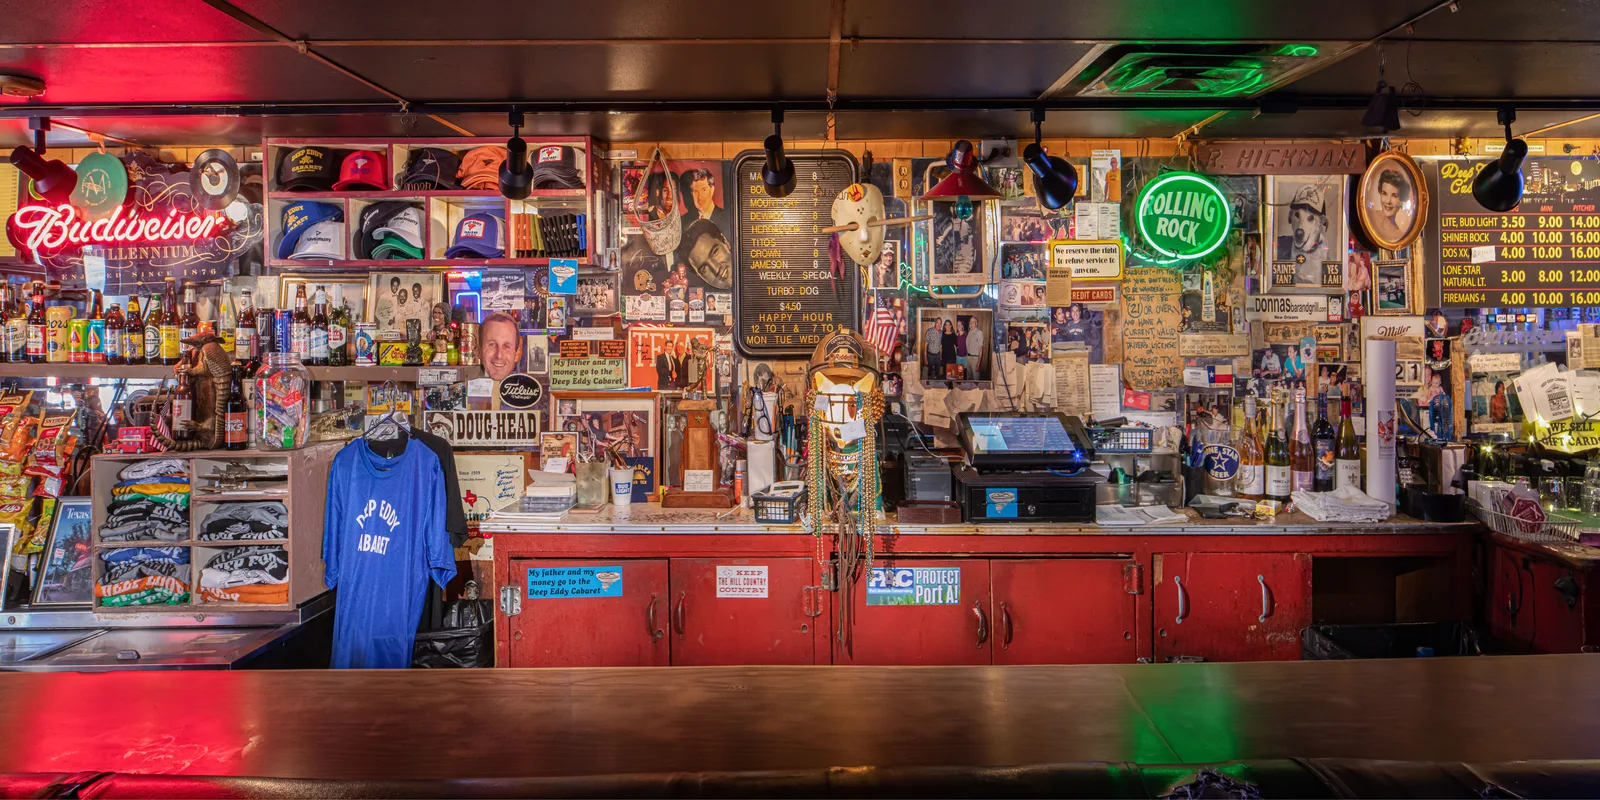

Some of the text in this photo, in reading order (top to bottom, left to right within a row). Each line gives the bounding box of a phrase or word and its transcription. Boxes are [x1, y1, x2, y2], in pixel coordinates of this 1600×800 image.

[1206, 149, 1356, 168] R. HICKMAN
[812, 172, 818, 180] 8
[813, 185, 818, 194] 7
[1144, 191, 1215, 222] ROLLING
[812, 212, 818, 220] 8
[1442, 216, 1600, 228] LITE, BUD LIGHT 3.50 9.00 14.00
[15, 204, 225, 251] Budweiser
[813, 224, 818, 233] 8
[1156, 217, 1200, 246] ROCK
[1442, 232, 1600, 243] SHINER BOCK 4.00 10.00 16.00
[750, 249, 781, 258] CROWN
[1443, 248, 1457, 258] DOS
[1458, 248, 1470, 258] XX,
[1501, 247, 1525, 258] 4.00
[1532, 247, 1562, 258] 10.00
[1570, 247, 1600, 258] 16.00
[750, 260, 819, 269] JAMESON 8
[1273, 264, 1338, 274] SAINTS YES
[1443, 266, 1481, 274] LONE STAR
[759, 272, 791, 280] WEEKLY
[1276, 274, 1292, 284] FAN?
[1328, 275, 1342, 284] AM!
[1501, 270, 1600, 282] 3.00 8.00 12.00
[1443, 278, 1486, 286] NATURAL LT.
[767, 286, 819, 296] TURBO DOG
[1092, 291, 1112, 299] CARDS
[1444, 292, 1600, 304] FIREMANS 4 4.00 10.00 16.00
[780, 302, 801, 311] $4.50
[1130, 304, 1140, 314] 21
[1144, 306, 1153, 314] OR
[803, 313, 833, 321] HOUR
[765, 324, 777, 333] TO
[793, 324, 799, 333] &
[822, 324, 834, 333] TO
[1378, 325, 1411, 337] Miller
[747, 335, 819, 344] MON TUE WED
[554, 359, 564, 367] My
[567, 358, 590, 367] father
[552, 378, 570, 386] Deep
[572, 378, 591, 386] Eddy
[457, 412, 536, 440] DOUG-HEAD
[1550, 422, 1594, 432] WE SELL
[1222, 448, 1238, 462] STAR
[1210, 469, 1229, 478] BEER
[67, 508, 89, 519] Texas
[379, 499, 400, 532] EDDY
[542, 568, 565, 577] father
[916, 570, 959, 584] PROTECT
[529, 588, 548, 596] Deep
[916, 585, 958, 604] Port A!
